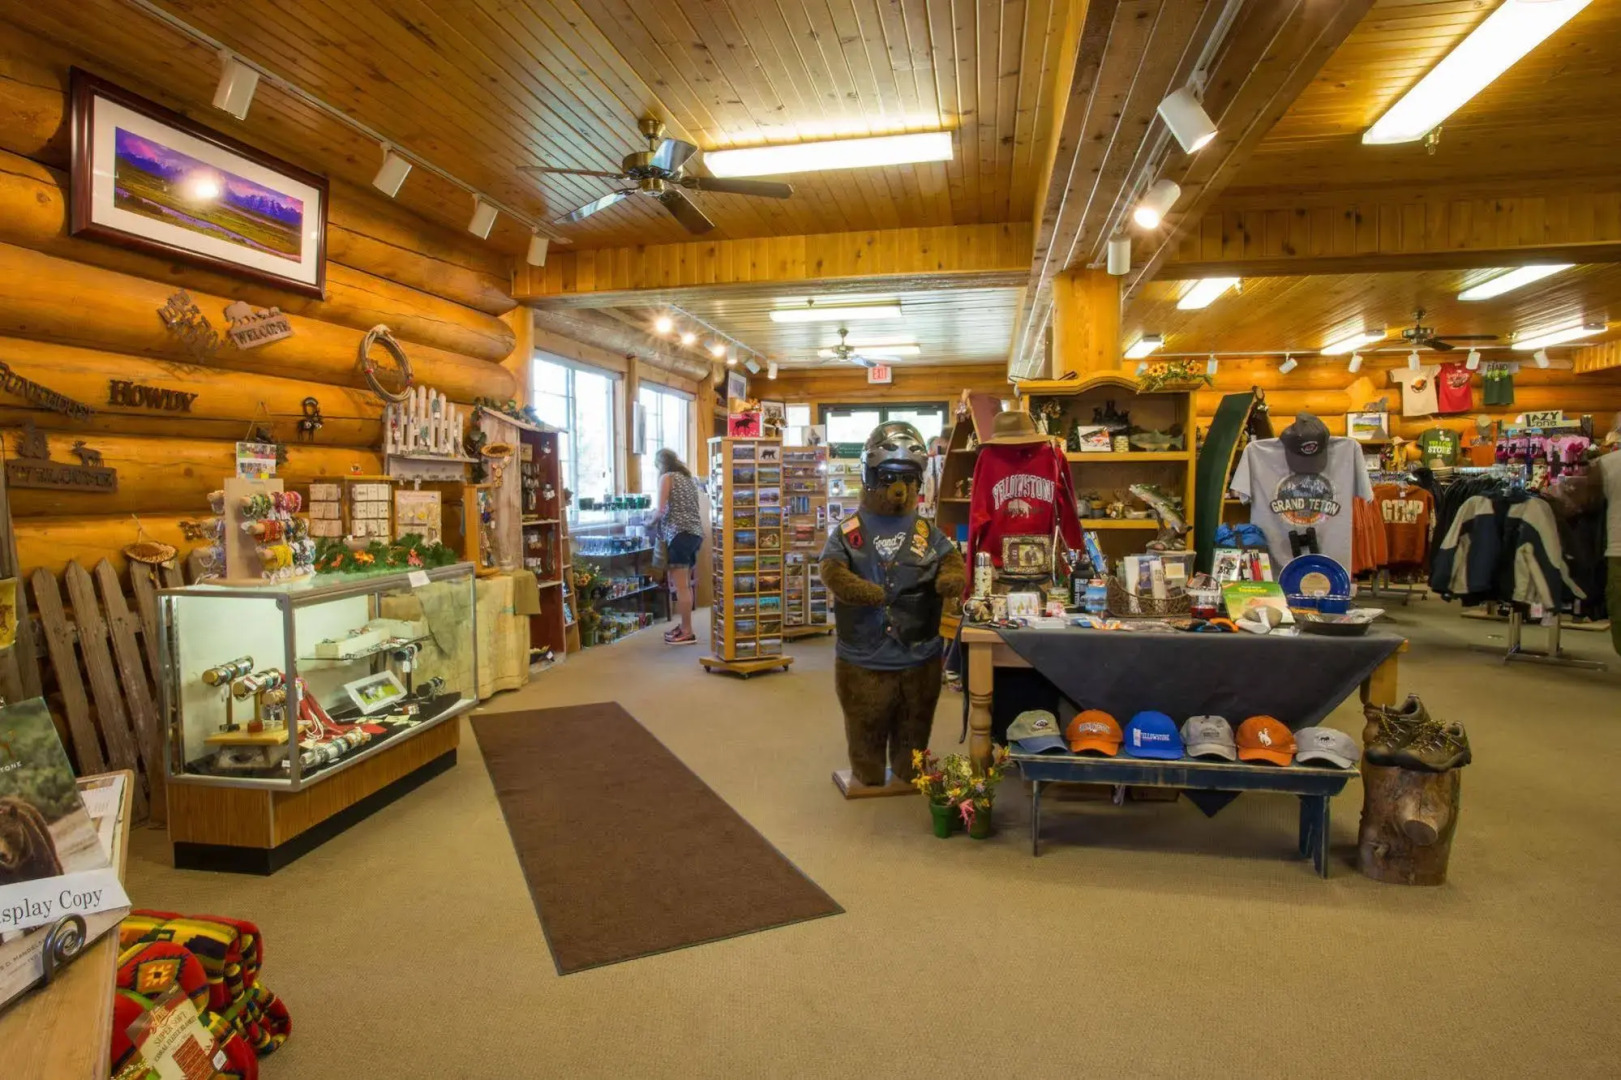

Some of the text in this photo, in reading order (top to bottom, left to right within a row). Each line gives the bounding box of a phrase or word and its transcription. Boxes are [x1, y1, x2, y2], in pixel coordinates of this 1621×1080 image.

[235, 320, 291, 345] WELCOME
[107, 379, 199, 413] HOWDY
[1525, 411, 1559, 427] LAZY
[1271, 498, 1339, 515] GRAND TETON
[0, 889, 103, 925] splay Copy
